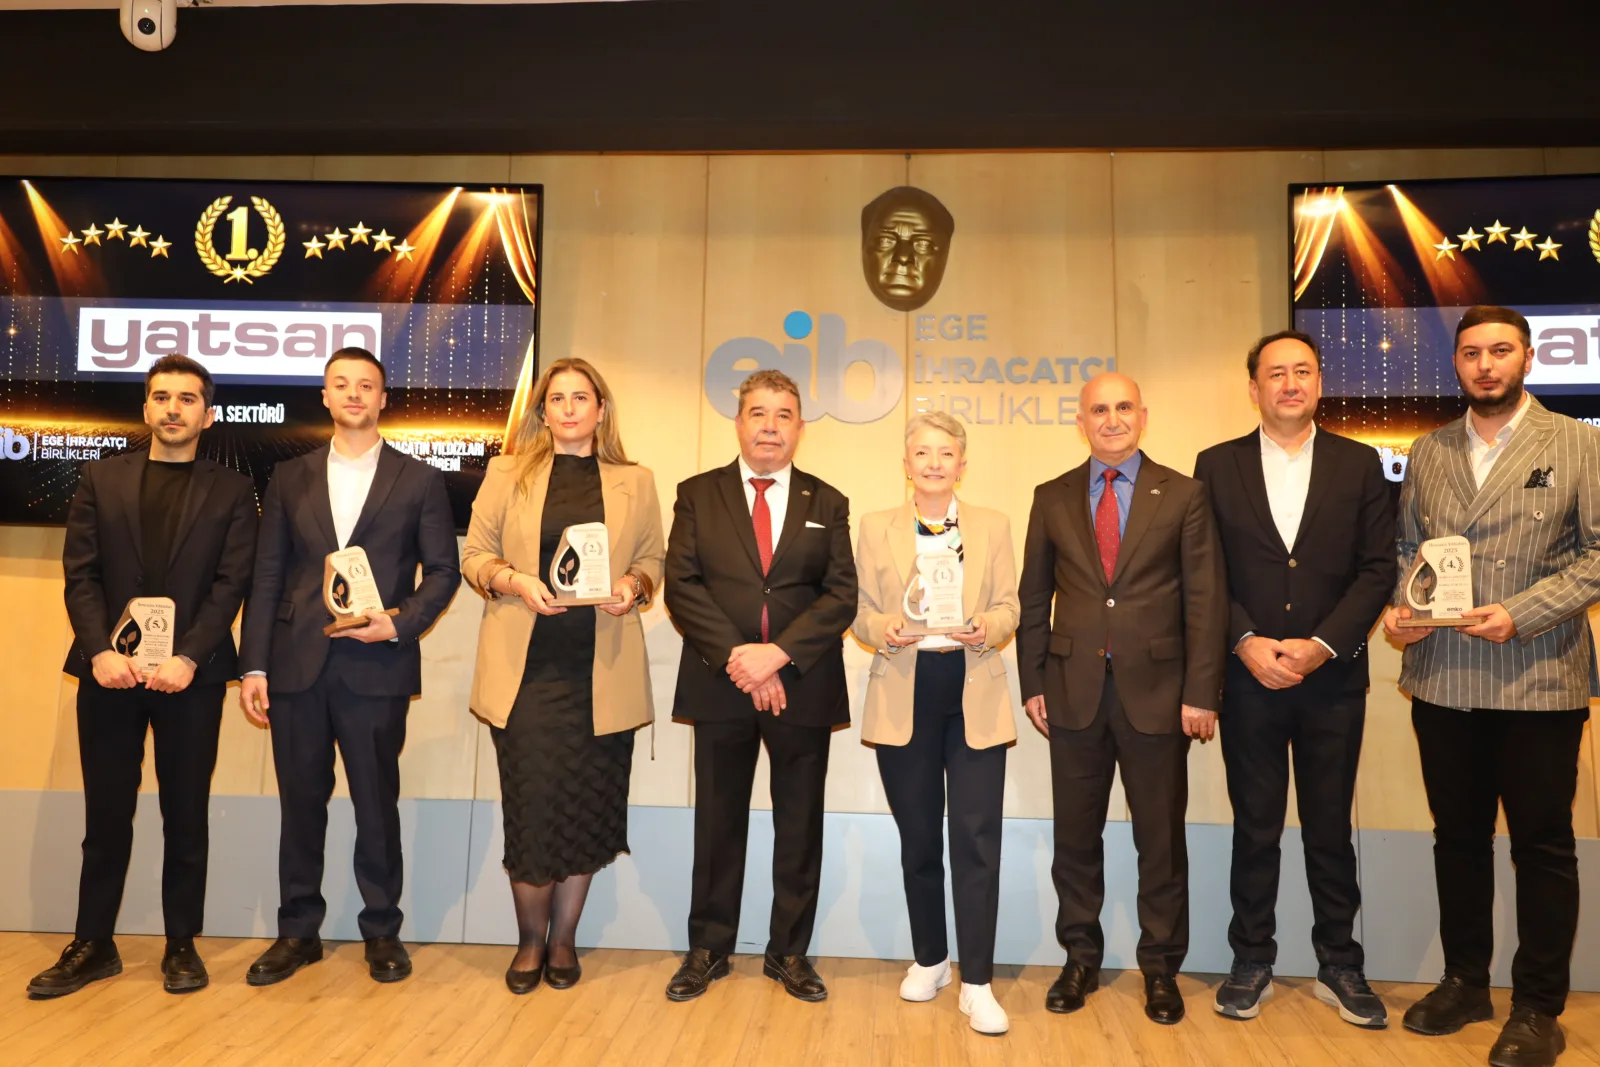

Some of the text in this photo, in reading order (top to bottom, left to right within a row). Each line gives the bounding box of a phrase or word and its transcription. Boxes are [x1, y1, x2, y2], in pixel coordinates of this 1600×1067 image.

[225, 206, 259, 261] 1.
[91, 313, 377, 368] yatsan
[915, 314, 988, 341] EGE
[705, 310, 904, 424] eib
[226, 403, 285, 423] SEKTÖRÜ
[41, 447, 100, 460] BİRLİKLERİ
[42, 434, 127, 450] EGE İHRACATÇI
